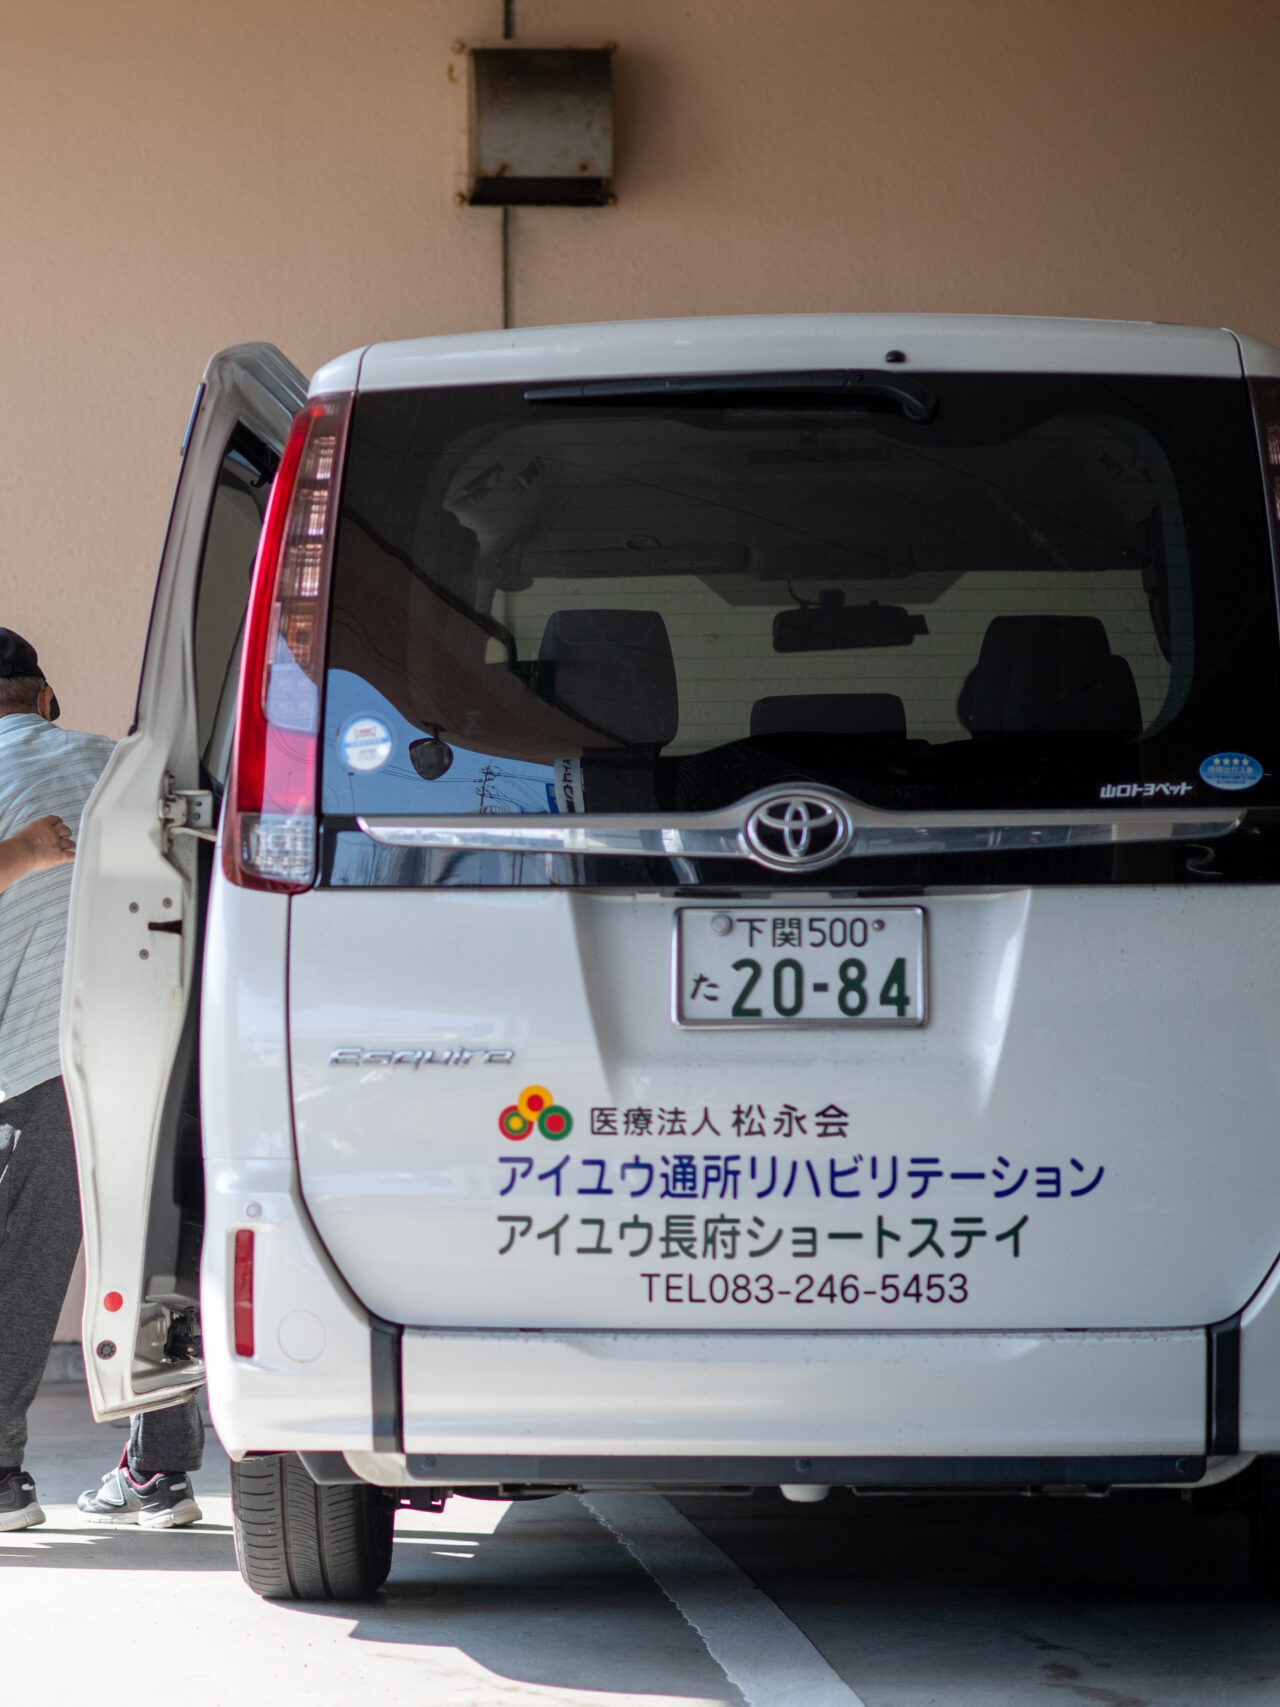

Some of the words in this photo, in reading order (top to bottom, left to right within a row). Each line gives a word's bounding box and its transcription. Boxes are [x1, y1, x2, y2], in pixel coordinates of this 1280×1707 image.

[1100, 782, 1193, 798] 山口トヨペット
[736, 917, 868, 948] 下関500
[690, 973, 720, 1001] た
[731, 957, 911, 1017] 20-84
[329, 1046, 515, 1070] Esquire
[498, 1154, 1105, 1199] アイユウ通所リハビリテーション
[497, 1214, 1029, 1260] アイユウ長府ショートステイ
[641, 1272, 969, 1304] TEL083-246-5453
